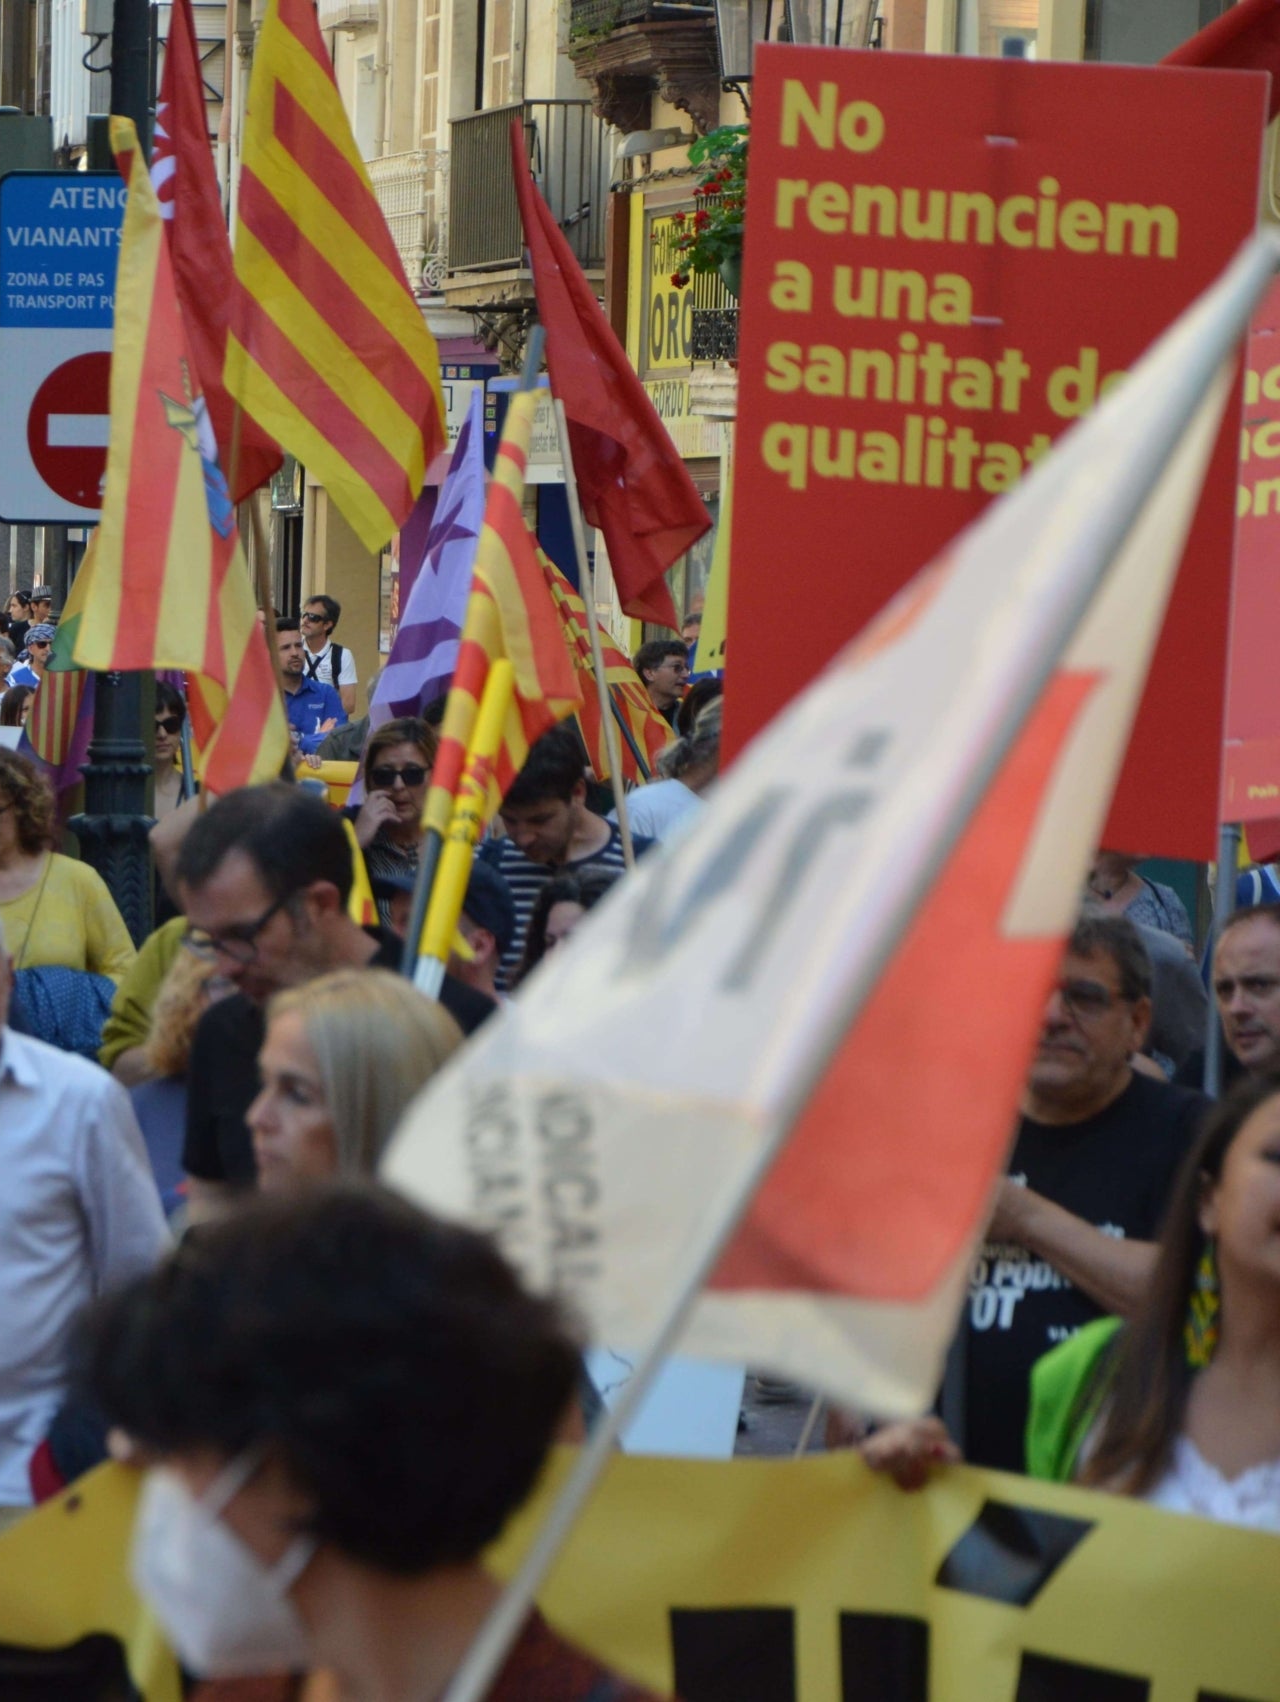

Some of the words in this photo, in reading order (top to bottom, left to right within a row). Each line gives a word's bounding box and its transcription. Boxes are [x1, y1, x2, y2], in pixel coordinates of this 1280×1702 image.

[780, 79, 885, 152] No
[49, 187, 129, 209] ATENC
[775, 176, 1179, 258] renunciem
[7, 273, 49, 286] ZONA
[54, 273, 72, 286] DE
[78, 273, 105, 286] PAS
[7, 295, 95, 309] TRANSPORT
[769, 260, 813, 312] a
[832, 264, 972, 325] una
[765, 331, 1030, 412] sanitat
